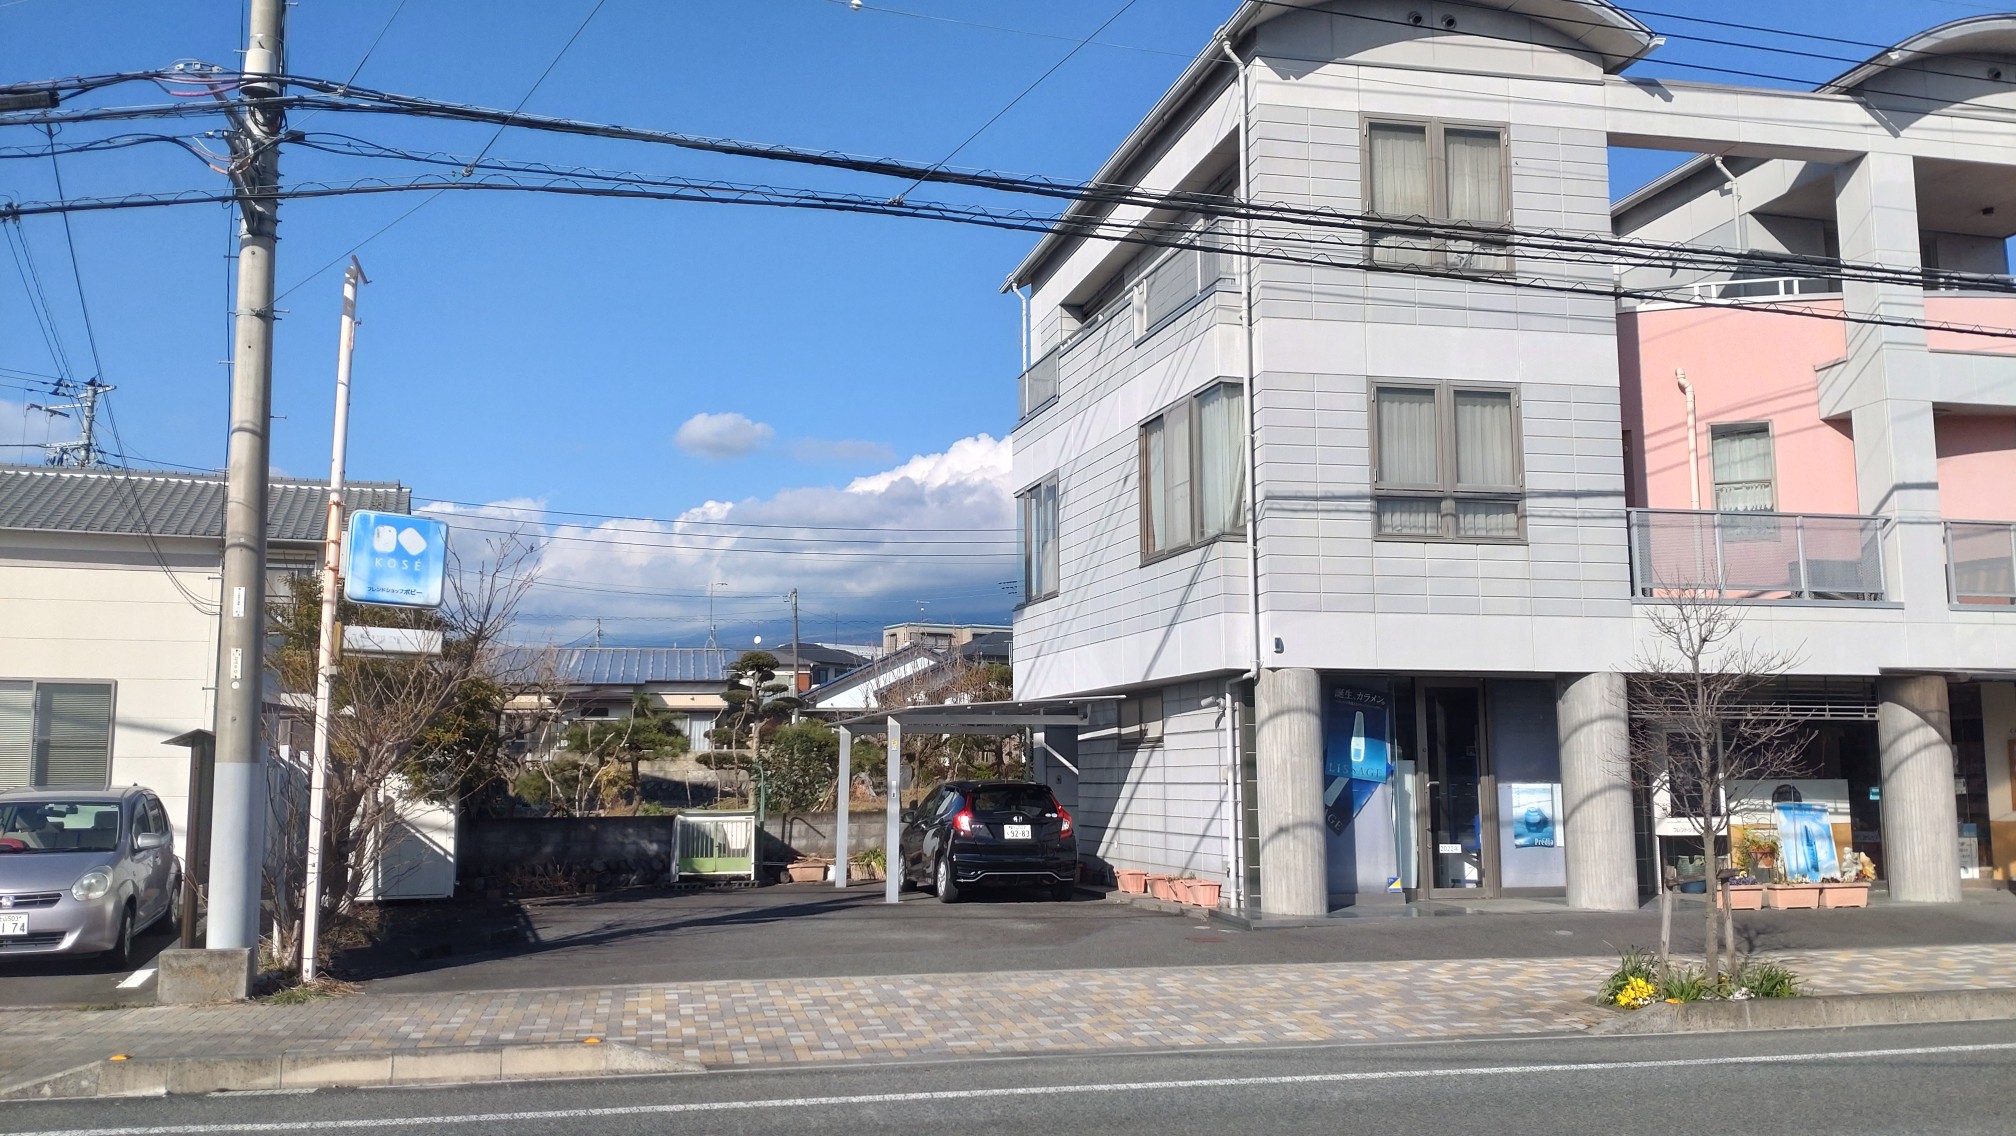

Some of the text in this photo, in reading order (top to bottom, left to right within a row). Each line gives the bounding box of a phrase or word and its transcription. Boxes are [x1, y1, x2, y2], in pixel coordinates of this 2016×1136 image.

[375, 558, 421, 571] KOSÉ
[1334, 688, 1386, 706] 誕生、カラメン。
[1328, 762, 1383, 778] LISSAGE
[1010, 829, 1030, 837] 92-83
